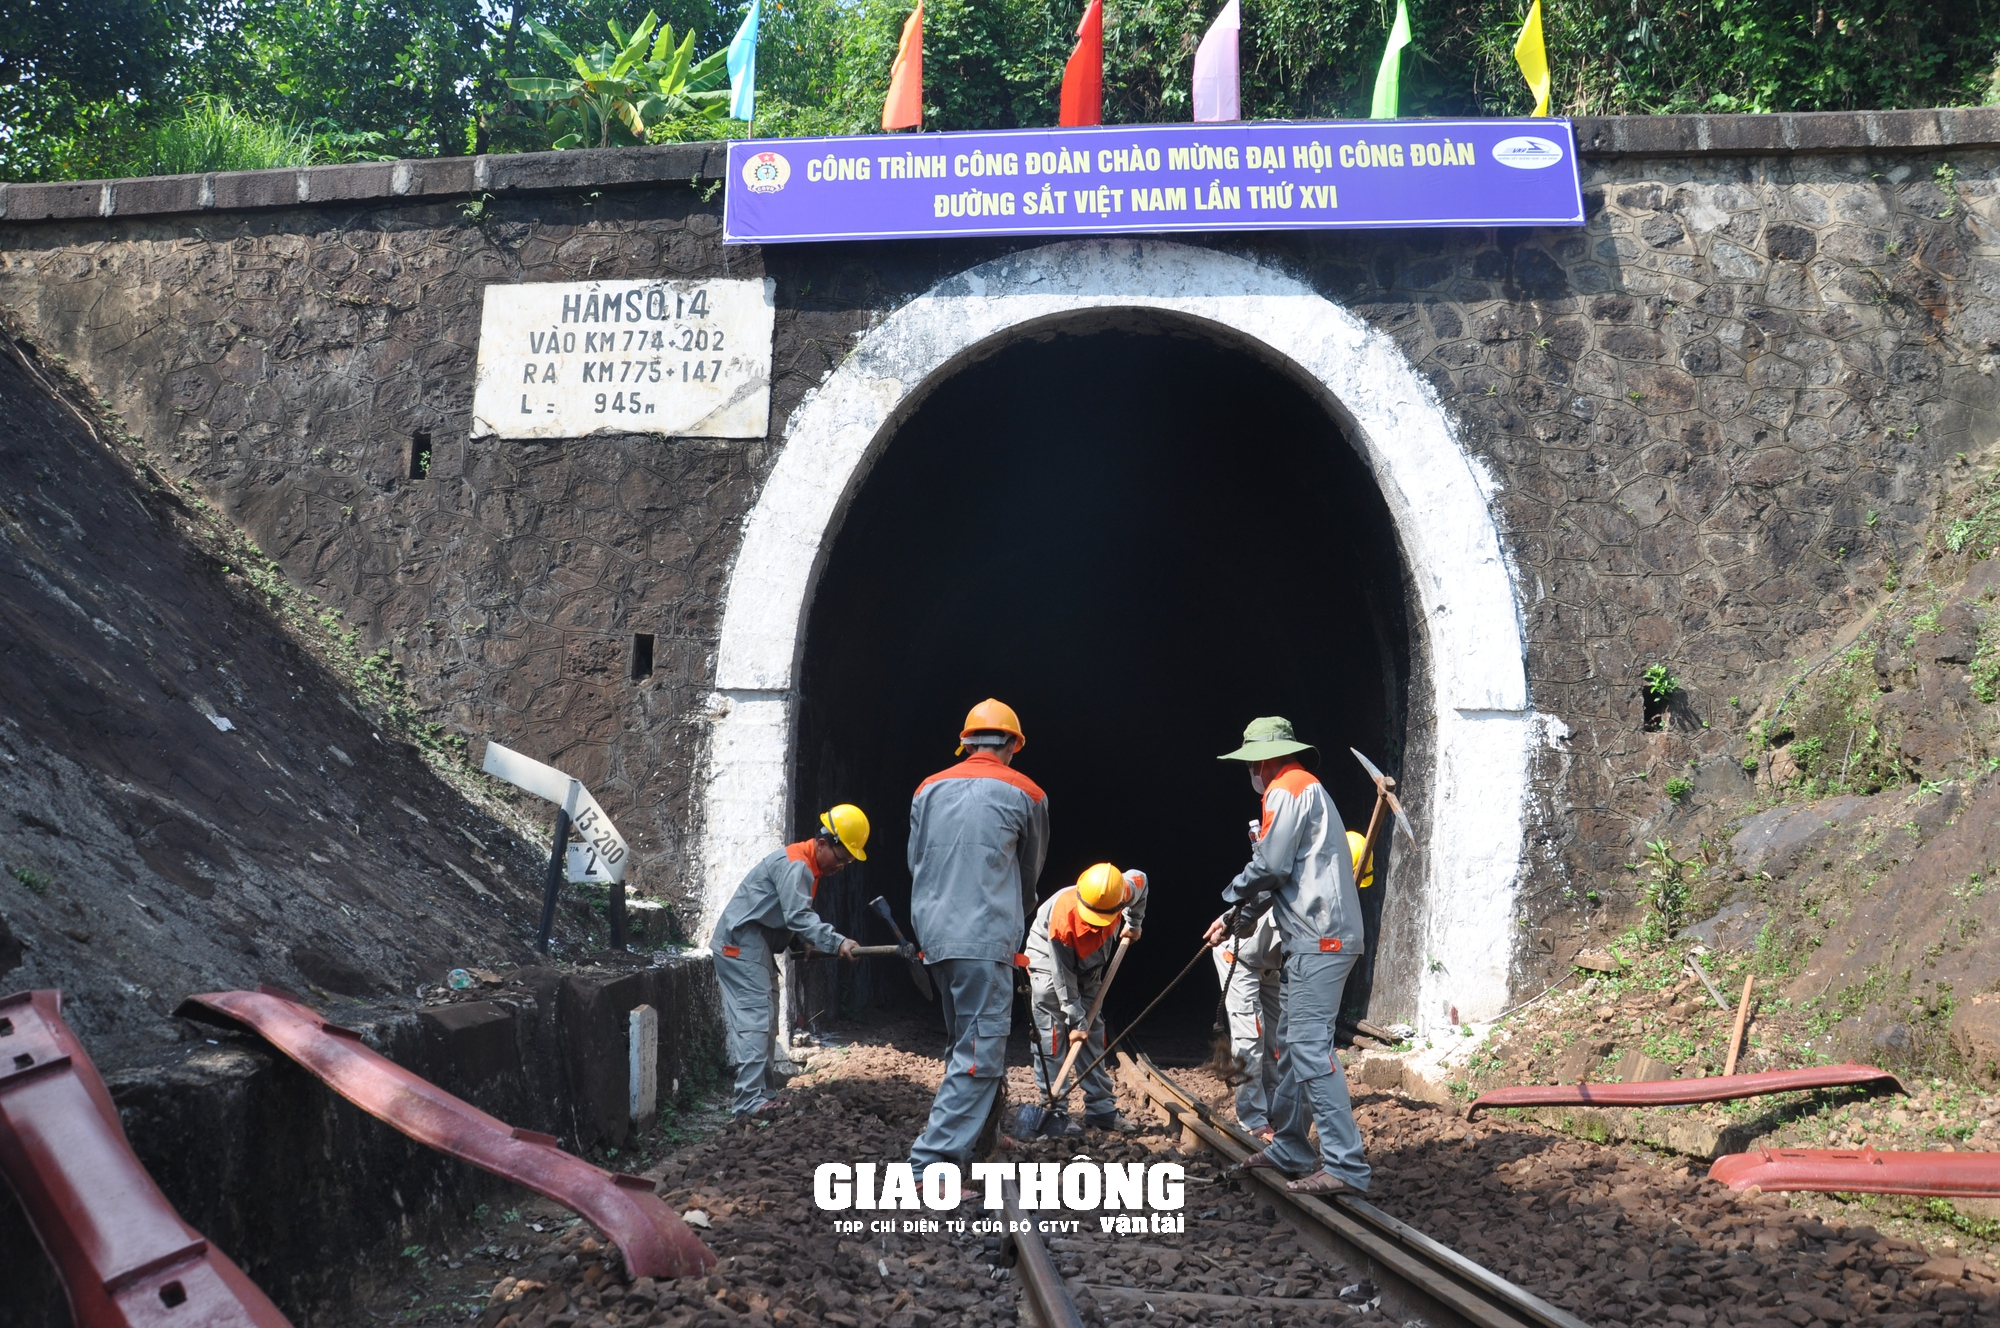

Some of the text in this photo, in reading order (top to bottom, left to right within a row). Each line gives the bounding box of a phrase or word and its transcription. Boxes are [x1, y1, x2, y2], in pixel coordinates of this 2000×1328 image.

[806, 137, 1476, 182] CÔNG TRÌNH CÔNG ĐOÀN CHÀO MỪNG ĐẠI HỘI CÔNG ĐOÀN
[933, 178, 1338, 219] ĐƯỜNG SẮT VIỆT NAM LẦN THỨ XVI
[675, 288, 710, 320] 14
[529, 325, 576, 354] VÀO
[585, 846, 598, 876] 2
